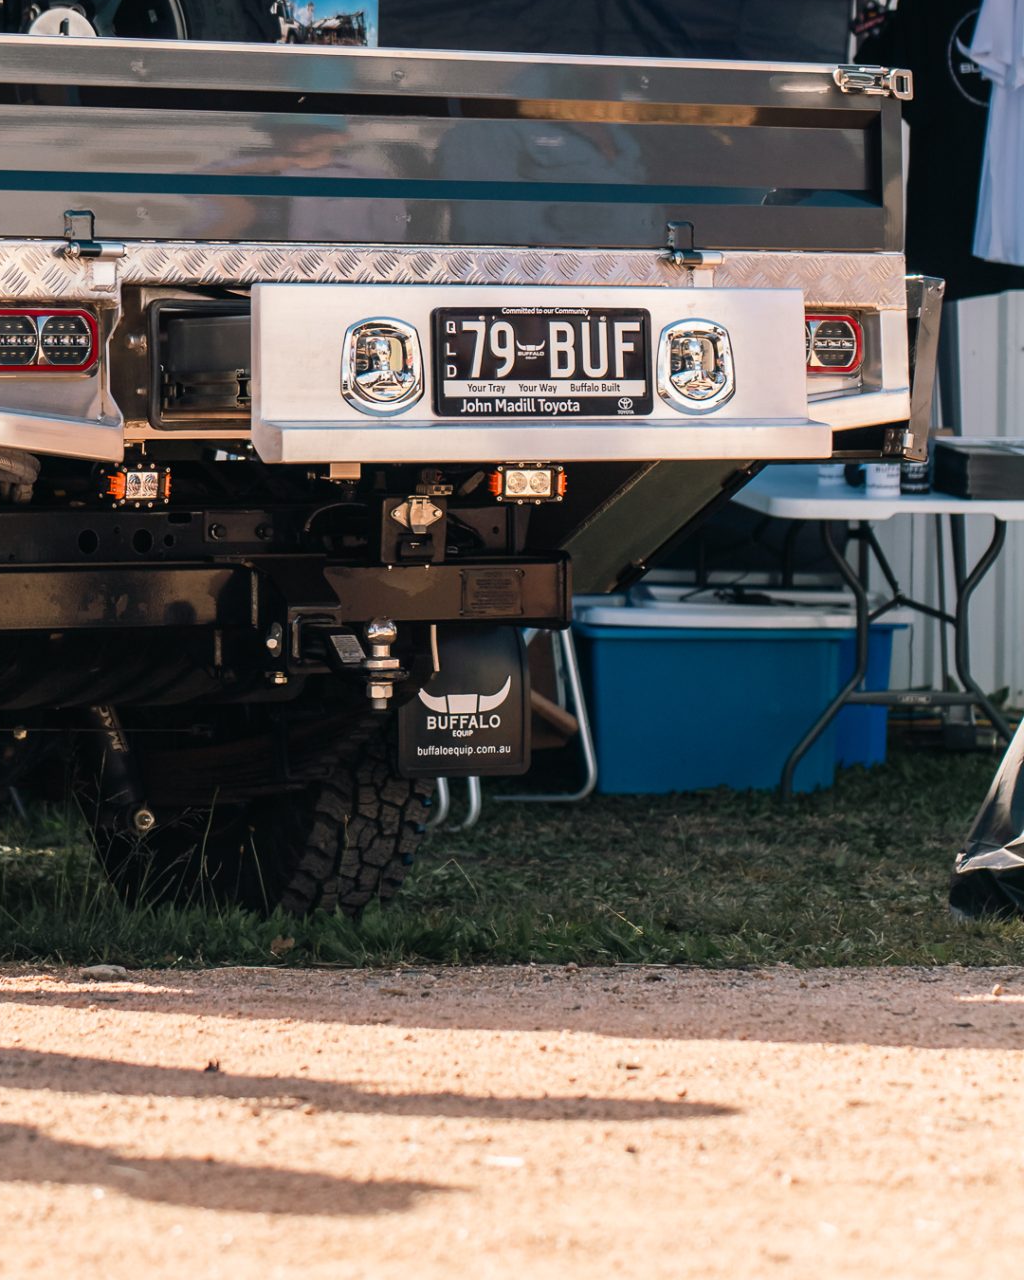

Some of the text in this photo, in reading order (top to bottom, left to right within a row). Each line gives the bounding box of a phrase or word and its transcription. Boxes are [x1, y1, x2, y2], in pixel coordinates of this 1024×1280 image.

[501, 307, 535, 315] Committed
[554, 307, 589, 316] Community
[462, 321, 641, 378] 79 BUF
[467, 383, 621, 394] Your Tray Your Way Buffalo Built
[461, 398, 580, 415] John Madill Toyota
[426, 714, 501, 730] BUFFALO
[452, 730, 474, 738] EQUIP
[417, 745, 511, 756] buffaloequip.com.au
